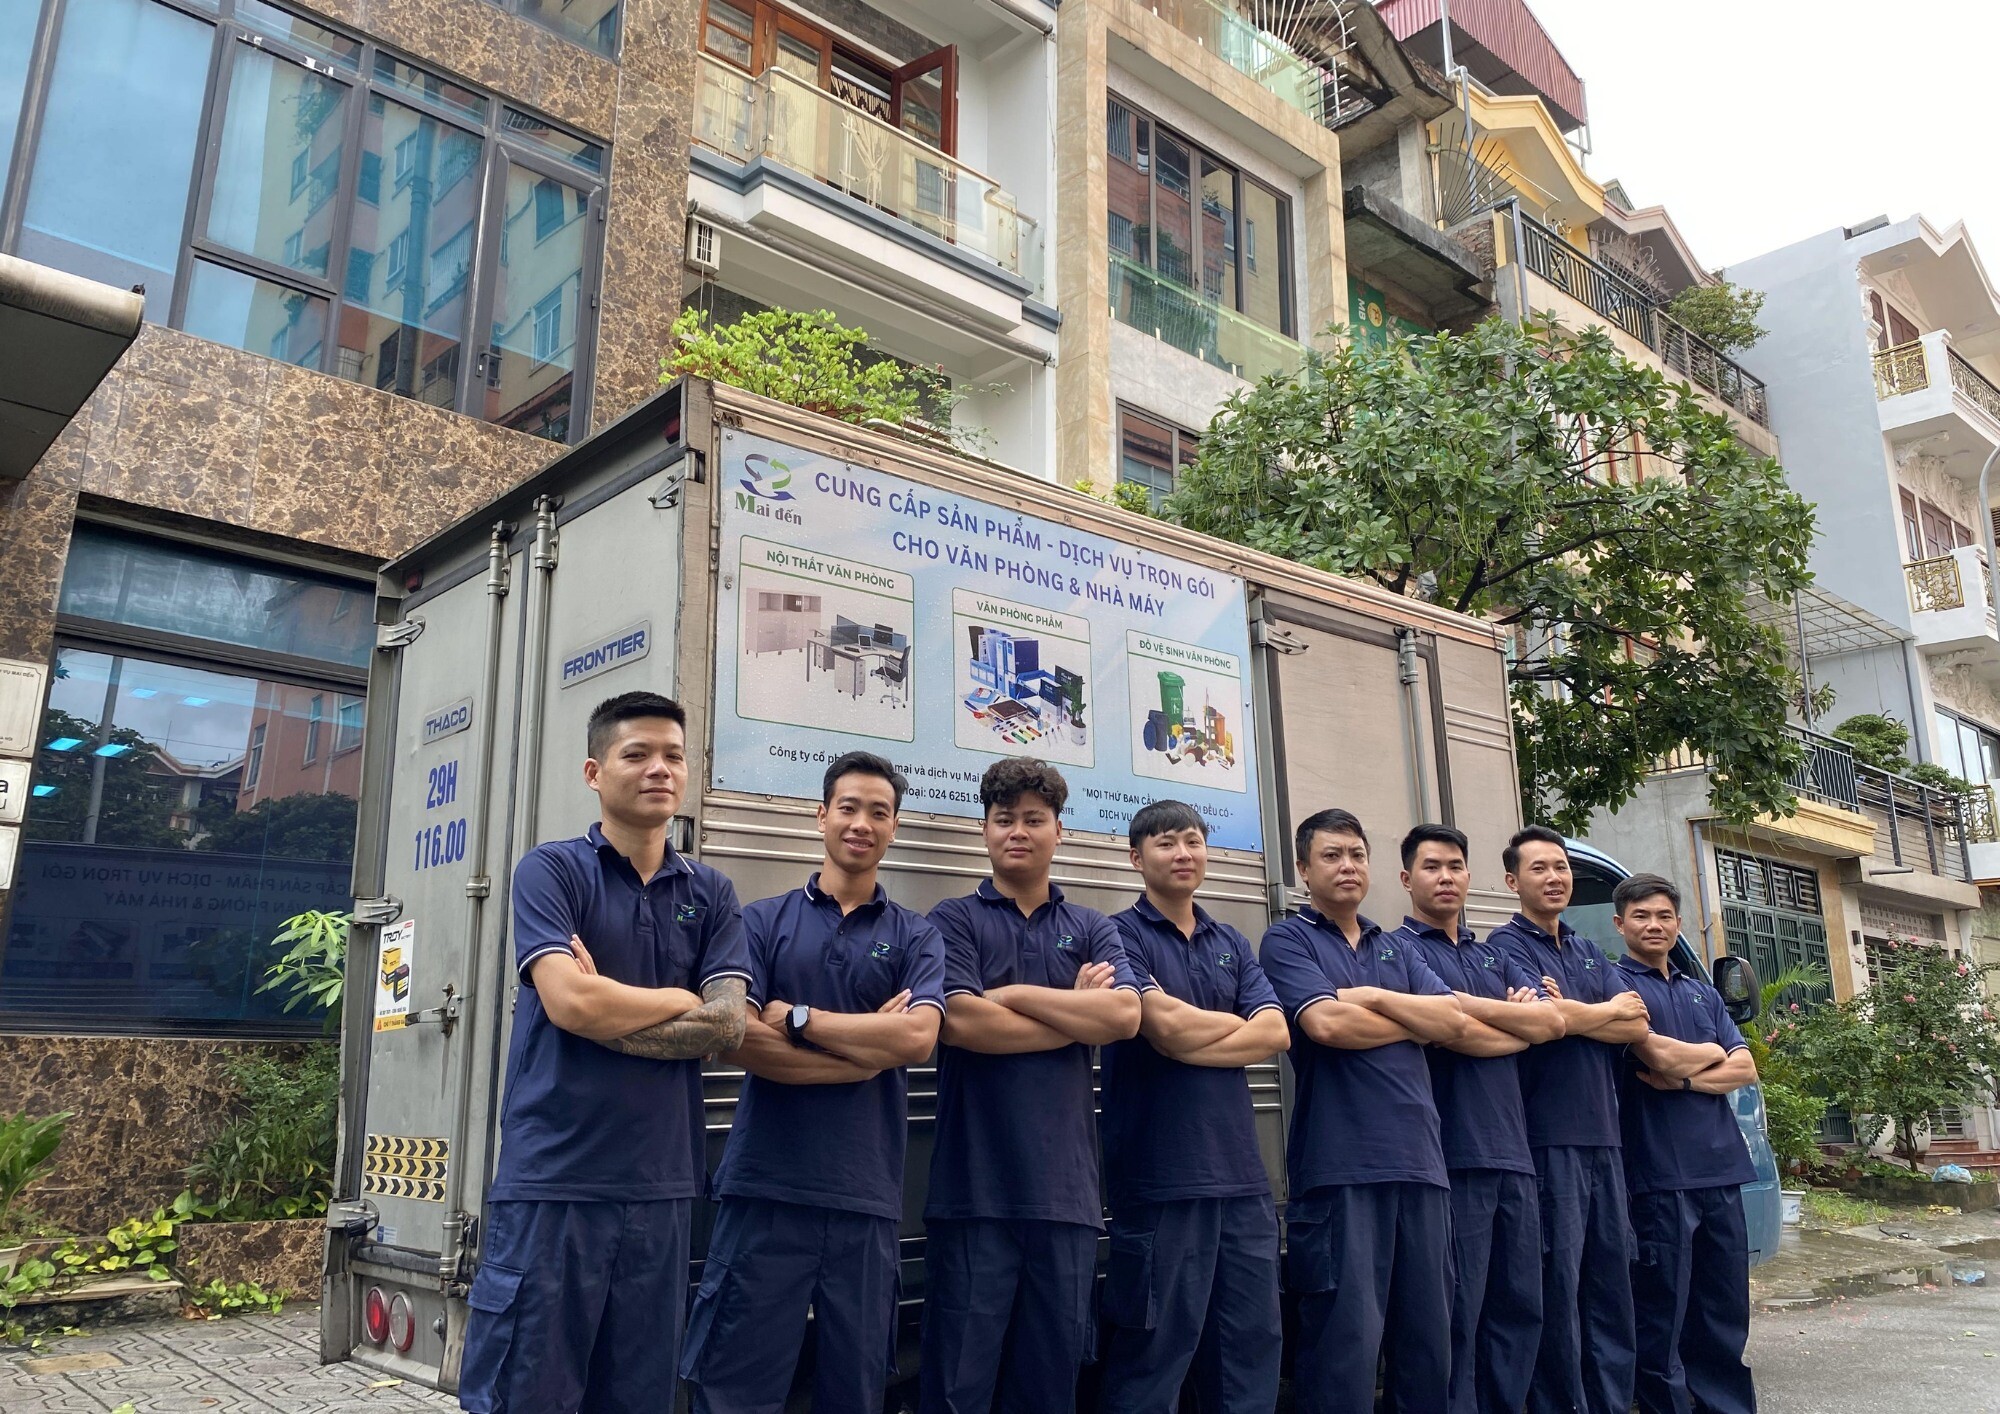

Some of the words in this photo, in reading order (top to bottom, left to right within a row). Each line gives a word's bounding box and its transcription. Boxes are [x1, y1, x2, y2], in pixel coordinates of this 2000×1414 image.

[1358, 298, 1366, 320] MB
[735, 491, 770, 517] Mai
[775, 507, 802, 526] đến
[815, 472, 881, 507] CUNG
[888, 488, 931, 519] CẤP
[937, 504, 978, 534] SẢN
[985, 519, 1041, 551] PHẨM
[1060, 541, 1104, 568] DỊCH
[1109, 554, 1132, 580] VỤ
[1137, 563, 1182, 590] TRỌN
[1187, 577, 1215, 599] GÓI
[766, 550, 789, 567] NỘI
[792, 556, 824, 573] THẤT
[826, 563, 851, 580] VĂN
[854, 571, 895, 589] PHÒNG
[892, 531, 939, 559] CHO
[946, 544, 988, 573] VĂN
[995, 557, 1064, 592] PHÒNG
[1069, 578, 1081, 597] &
[1087, 581, 1124, 607] NHÀ
[1129, 593, 1165, 617] MÁY
[976, 600, 998, 615] VĂN
[1000, 607, 1034, 623] PHÒNG
[562, 629, 646, 681] FRONTIER
[1153, 643, 1164, 656] VỆ
[1165, 646, 1185, 659] SINH
[1204, 656, 1231, 669] PHÒNG
[426, 705, 468, 736] THACO
[769, 745, 797, 761] Công
[799, 750, 810, 763] ty
[895, 764, 912, 776] mại
[914, 765, 926, 776] và
[927, 766, 948, 779] dịch
[950, 771, 961, 782] vụ
[963, 771, 980, 783] Mai
[426, 760, 459, 810] 29H
[928, 788, 947, 799] 024
[949, 790, 971, 803] 6251
[1104, 790, 1122, 802] THỨ
[1123, 793, 1140, 806] BẠN
[1099, 809, 1120, 821] DỊCH
[1203, 803, 1218, 816] ĐỀU
[1218, 807, 1229, 818] CÓ
[414, 817, 467, 872] 116.00
